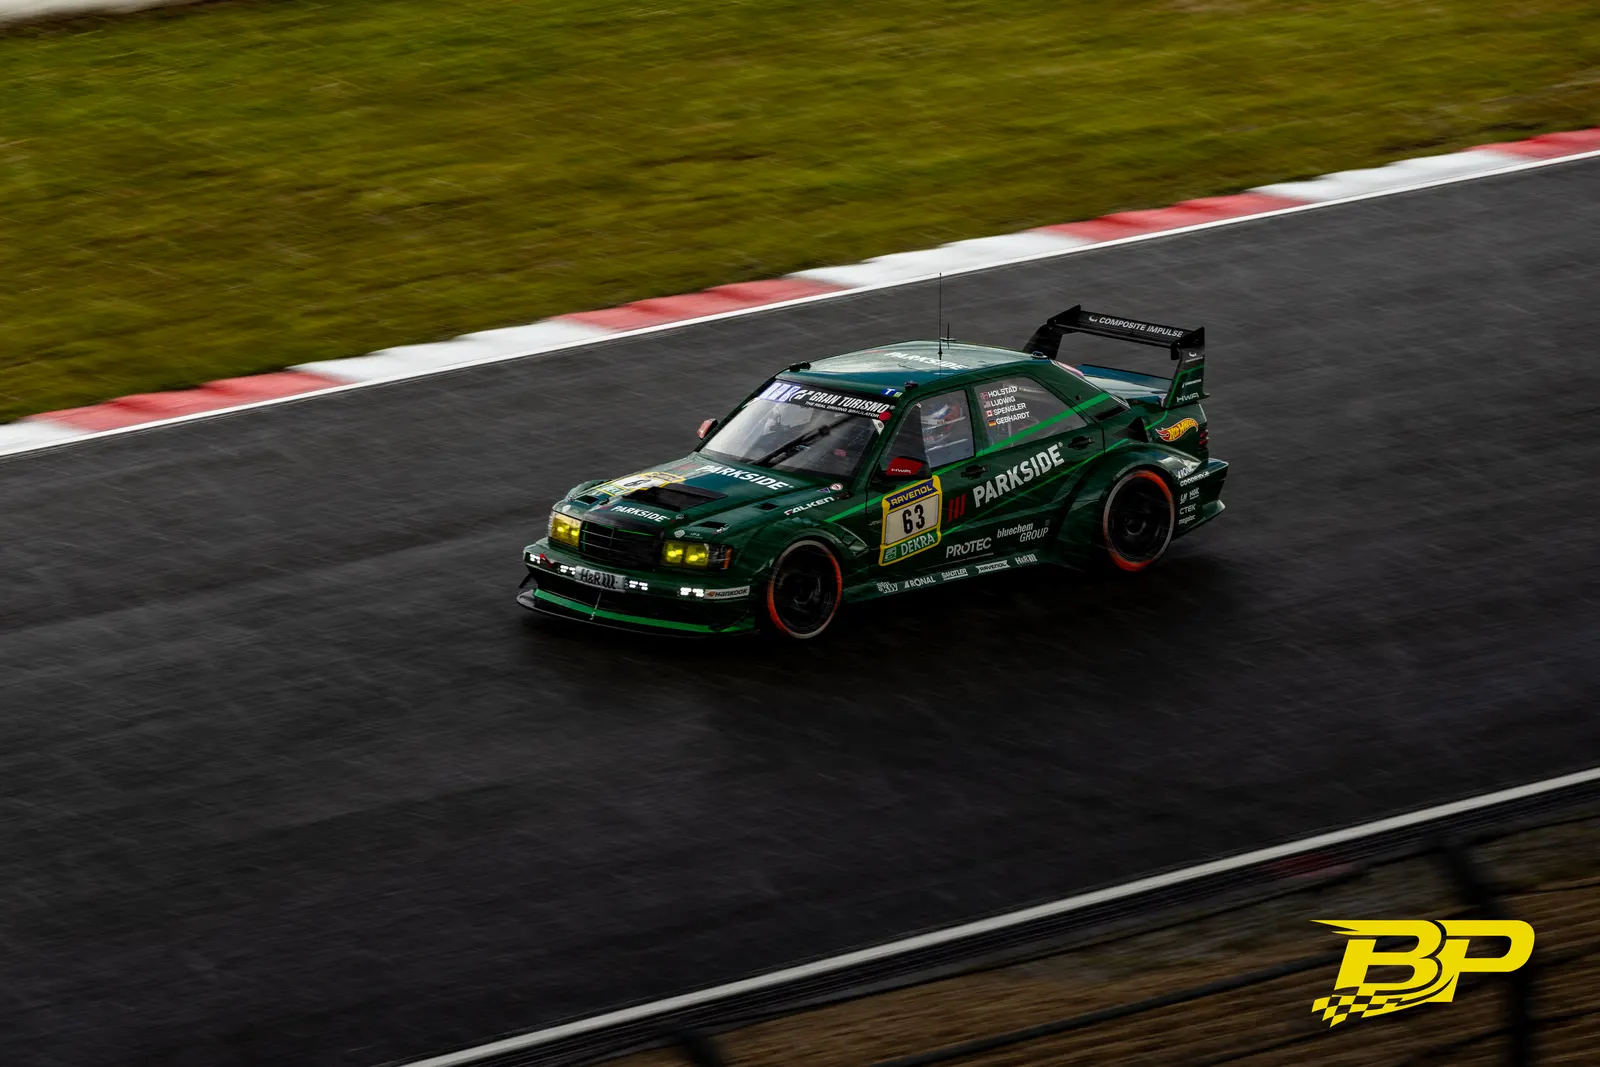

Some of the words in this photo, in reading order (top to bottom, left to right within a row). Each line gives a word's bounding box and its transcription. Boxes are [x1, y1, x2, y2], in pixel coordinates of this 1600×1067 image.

[1098, 316, 1147, 331] COMPOSITE
[1146, 325, 1184, 338] IMPULSE
[988, 385, 1018, 398] HOLSTAD
[1176, 392, 1200, 403] HWA
[810, 391, 841, 405] GRAN
[838, 395, 890, 414] TURISMO
[990, 395, 1016, 407] LUDWIG
[993, 402, 1027, 416] SPENGLER
[848, 408, 879, 418] SIMULATOR
[995, 411, 1030, 425] GEBHARDT
[695, 464, 789, 490] PARKSIDE
[972, 444, 1065, 508] PARKSIDE
[890, 484, 933, 506] RAVENOL
[610, 505, 668, 522] PARKSIDE
[783, 496, 835, 515] FALKEN
[1179, 503, 1196, 515] CTEK
[902, 504, 926, 534] 63
[996, 522, 1034, 539] bluechem
[1020, 527, 1049, 542] GROUP
[900, 533, 935, 556] DEKRA
[946, 537, 992, 559] PROTEC
[909, 576, 936, 588] RONAL
